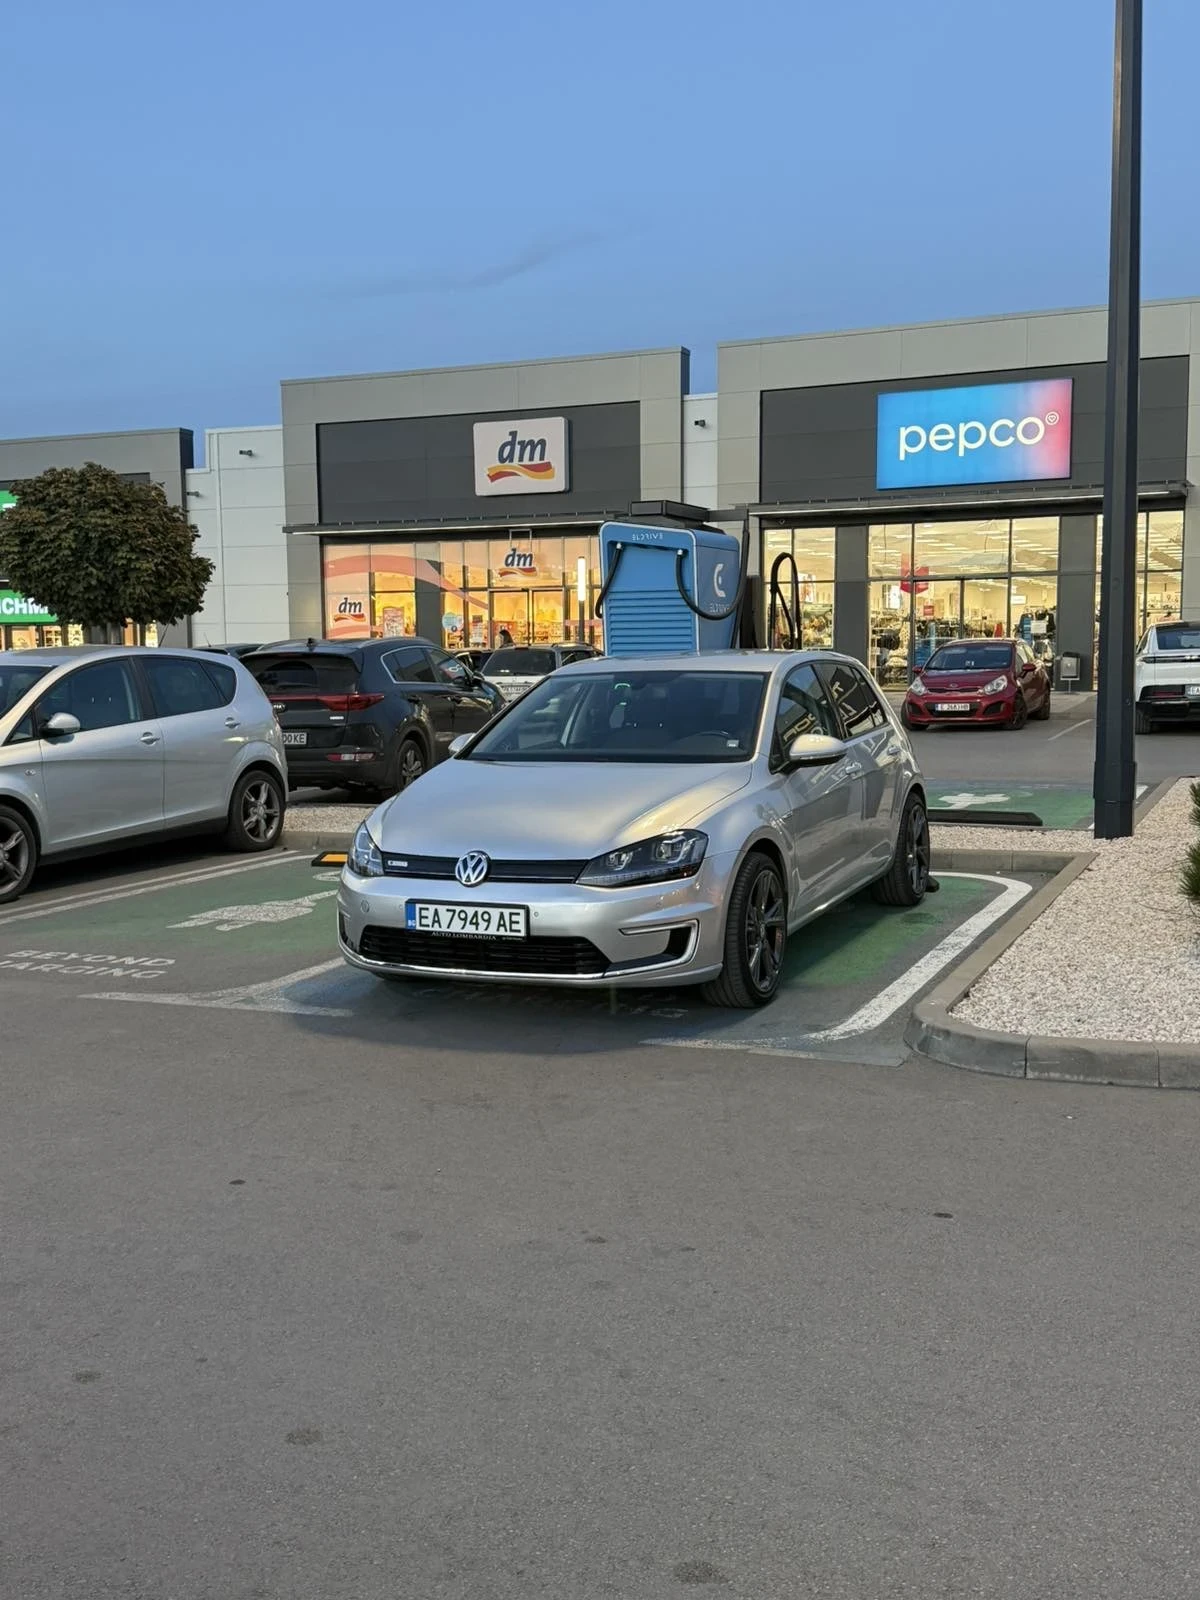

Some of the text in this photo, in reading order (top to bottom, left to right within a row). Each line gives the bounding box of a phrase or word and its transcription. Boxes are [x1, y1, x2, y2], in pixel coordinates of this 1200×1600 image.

[498, 430, 547, 464] dm
[899, 415, 1045, 461] pepco
[504, 548, 533, 568] dm
[338, 597, 362, 614] dm
[294, 733, 305, 743] KE
[418, 907, 442, 929] EA
[446, 908, 492, 931] 7949
[496, 911, 522, 933] AE
[4, 950, 176, 966] BEYOND
